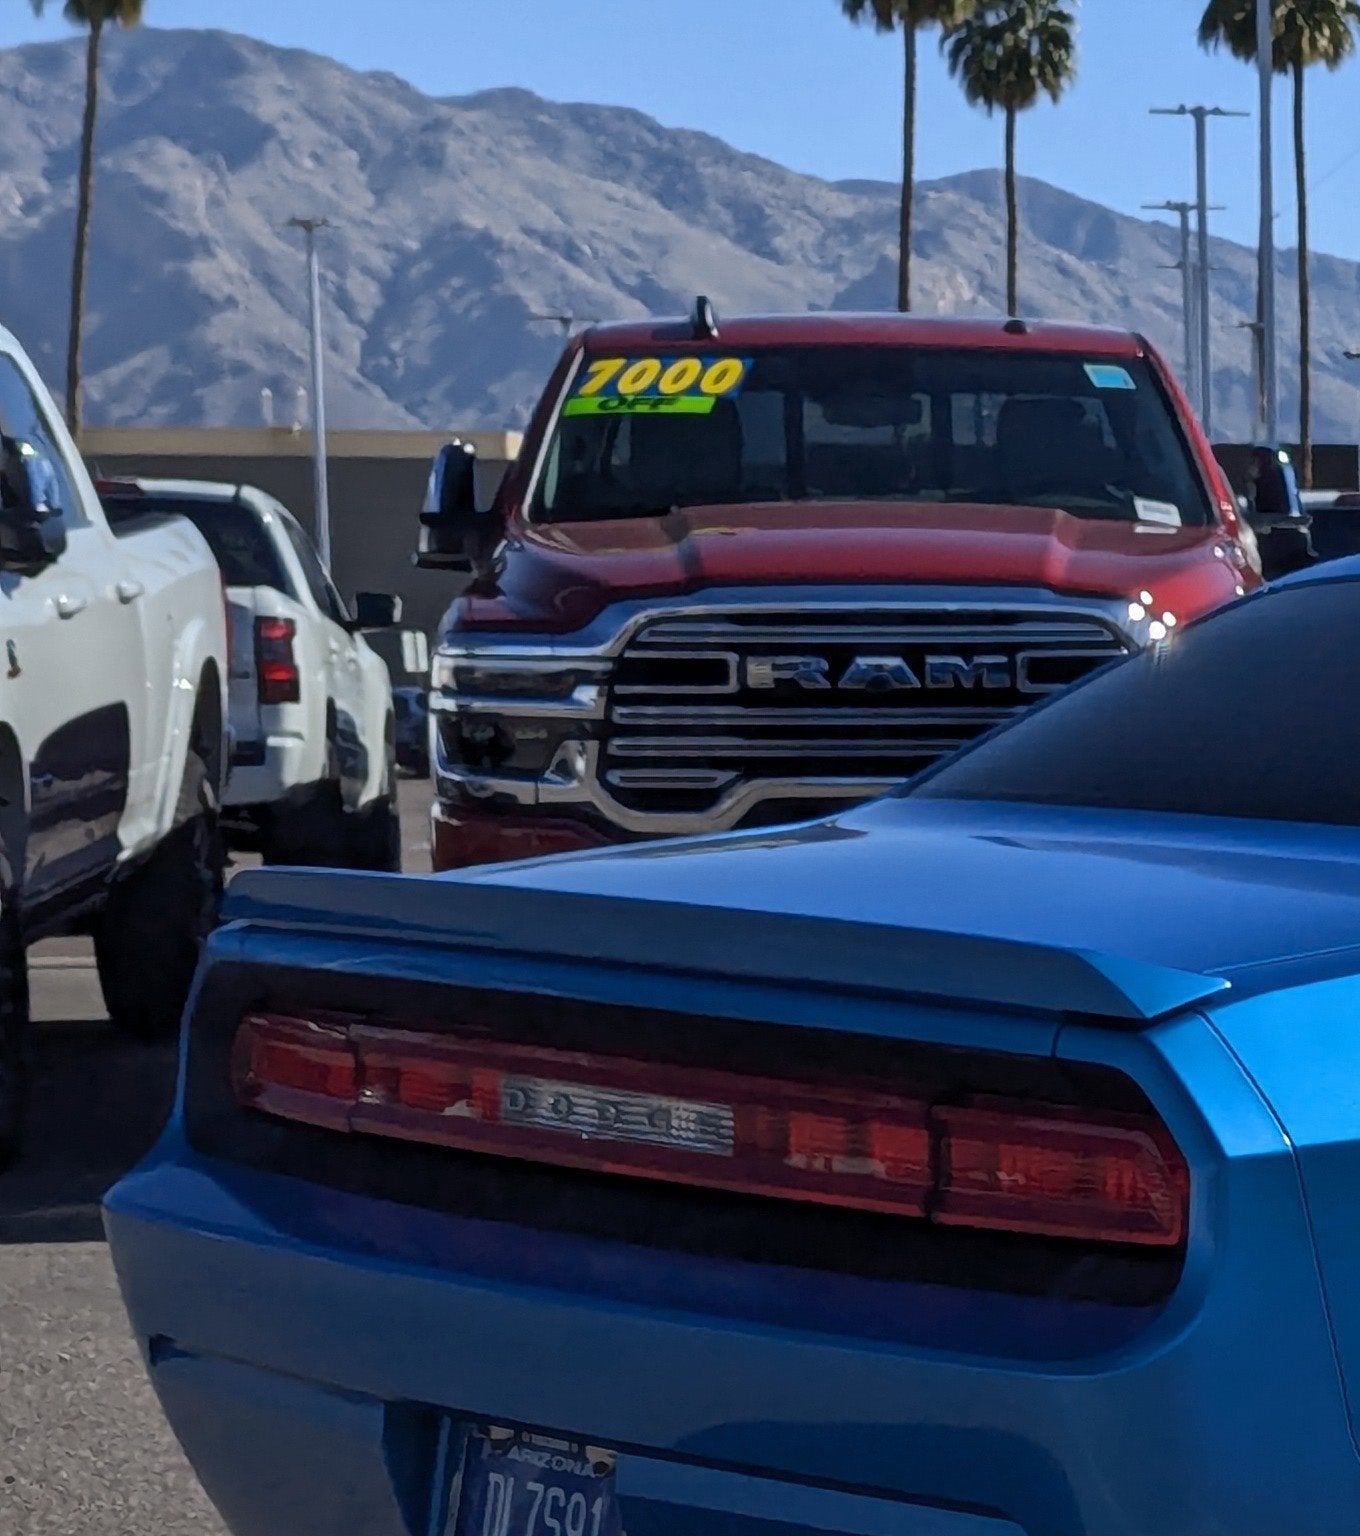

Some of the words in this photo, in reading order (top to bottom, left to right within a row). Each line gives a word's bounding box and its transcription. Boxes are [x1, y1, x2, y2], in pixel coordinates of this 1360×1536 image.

[578, 356, 744, 395] 7000
[597, 396, 680, 410] OFF
[746, 654, 1012, 689] RAM
[506, 1445, 597, 1479] ARIZONA
